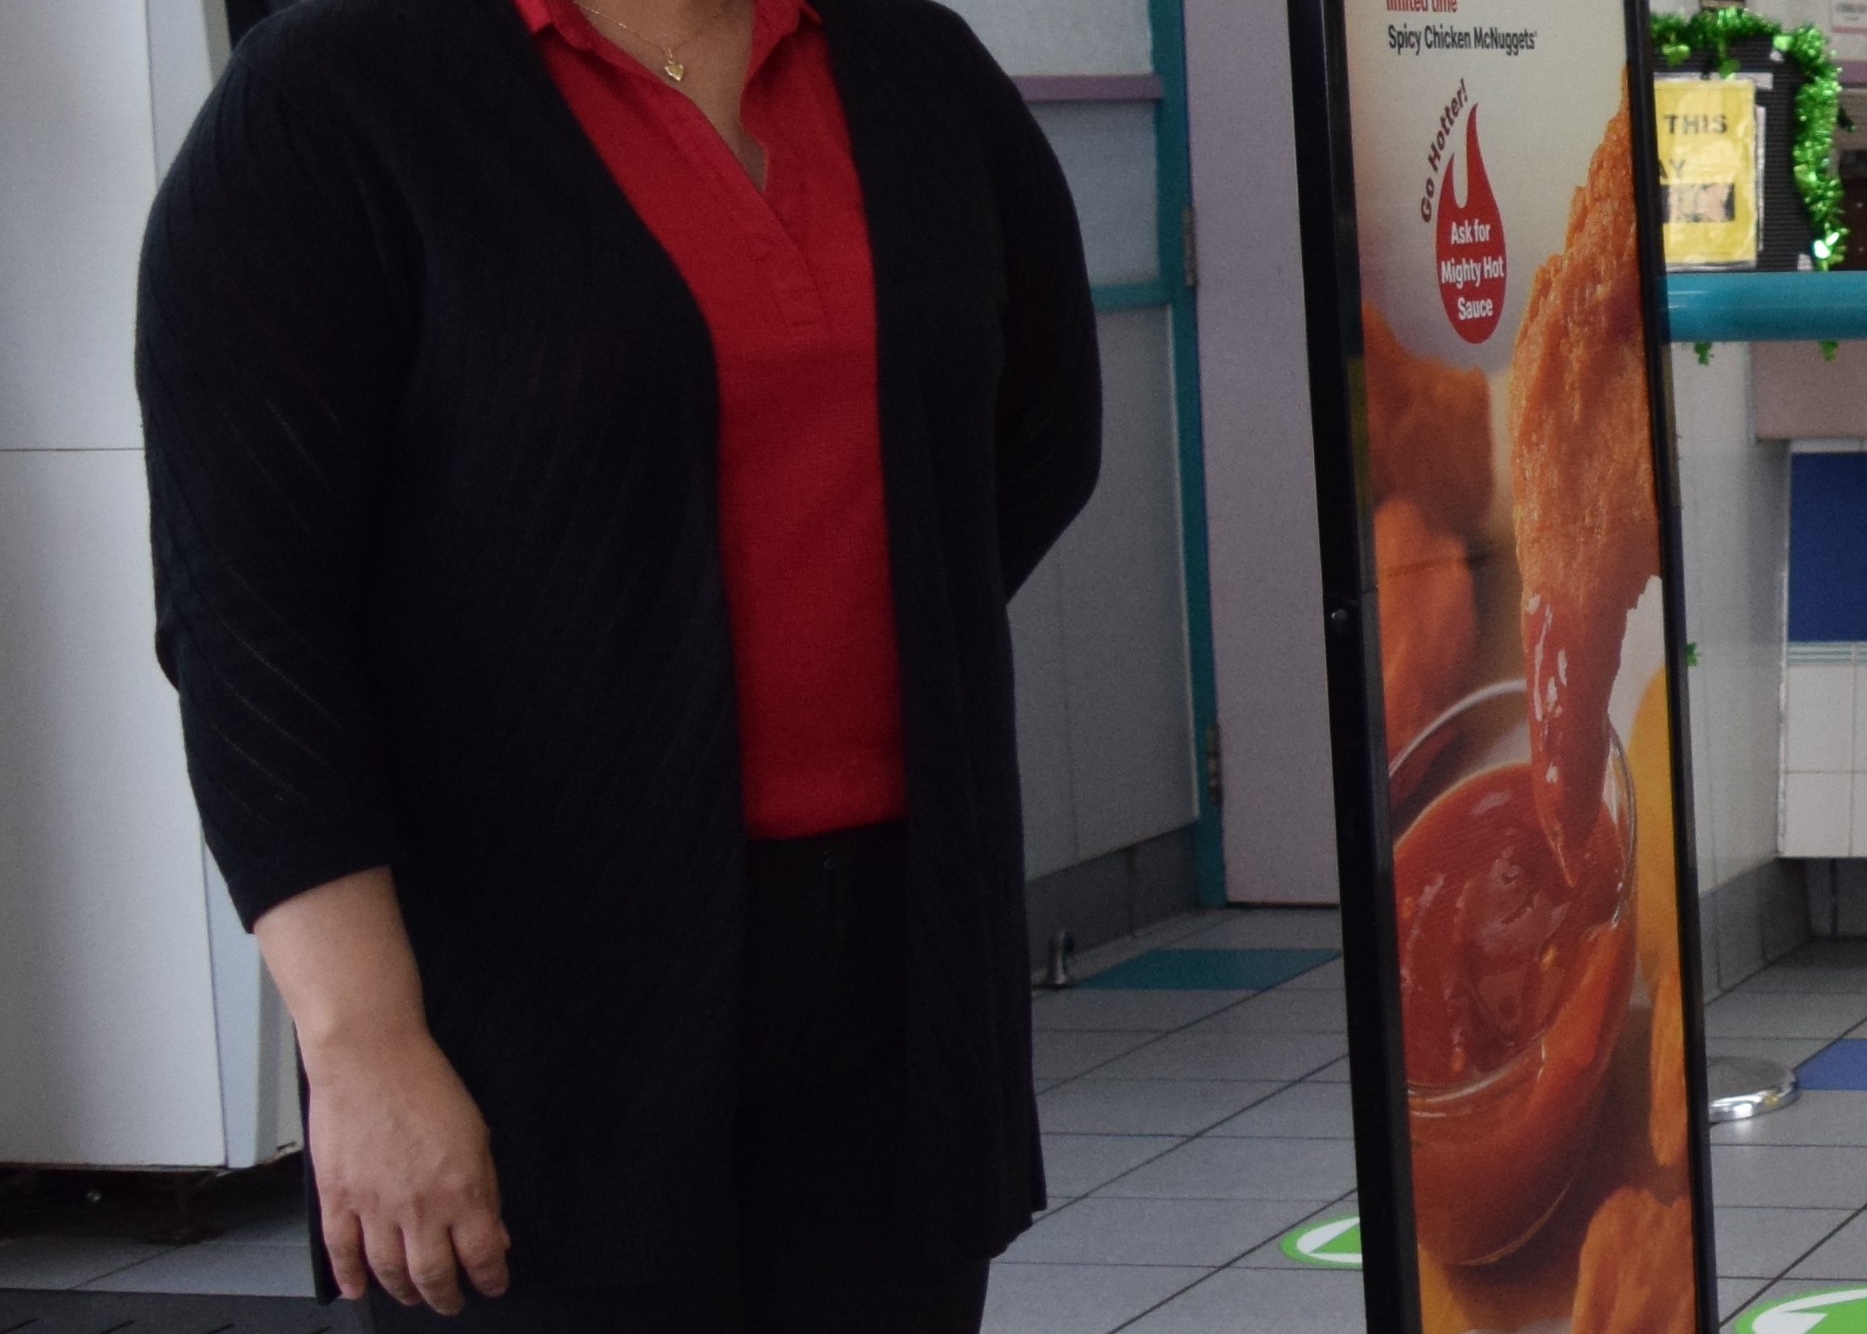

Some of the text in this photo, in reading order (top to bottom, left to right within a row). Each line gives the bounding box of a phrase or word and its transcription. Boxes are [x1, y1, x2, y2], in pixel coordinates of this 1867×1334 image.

[1388, 23, 1537, 56] Spicy Chicken McNuggets
[1663, 114, 1728, 135] THIS
[1420, 77, 1469, 224] Go Hotter!
[1451, 220, 1491, 245] Ask for
[1441, 255, 1505, 290] Mighty Hot
[1457, 297, 1494, 321] Sauce
